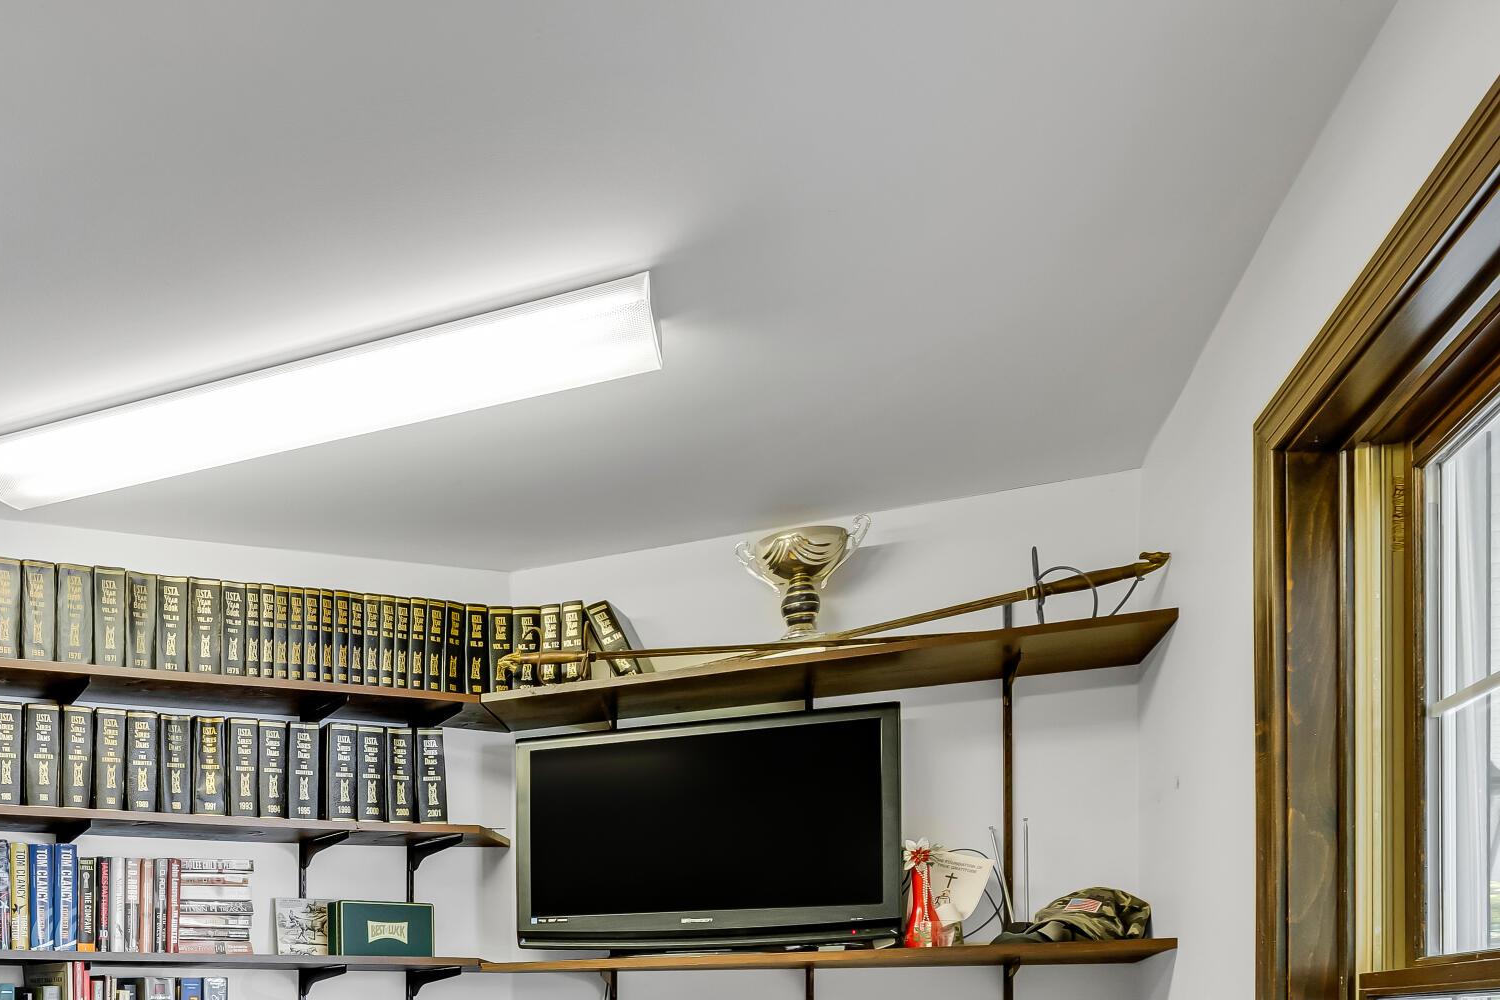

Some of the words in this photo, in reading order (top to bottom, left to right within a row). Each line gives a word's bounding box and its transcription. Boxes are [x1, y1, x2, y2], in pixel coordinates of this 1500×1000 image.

[16, 851, 25, 868] TOM
[37, 850, 47, 869] TOM
[17, 870, 25, 899] CLANCY
[37, 870, 47, 902] CLANCY
[371, 925, 385, 938] BEST
